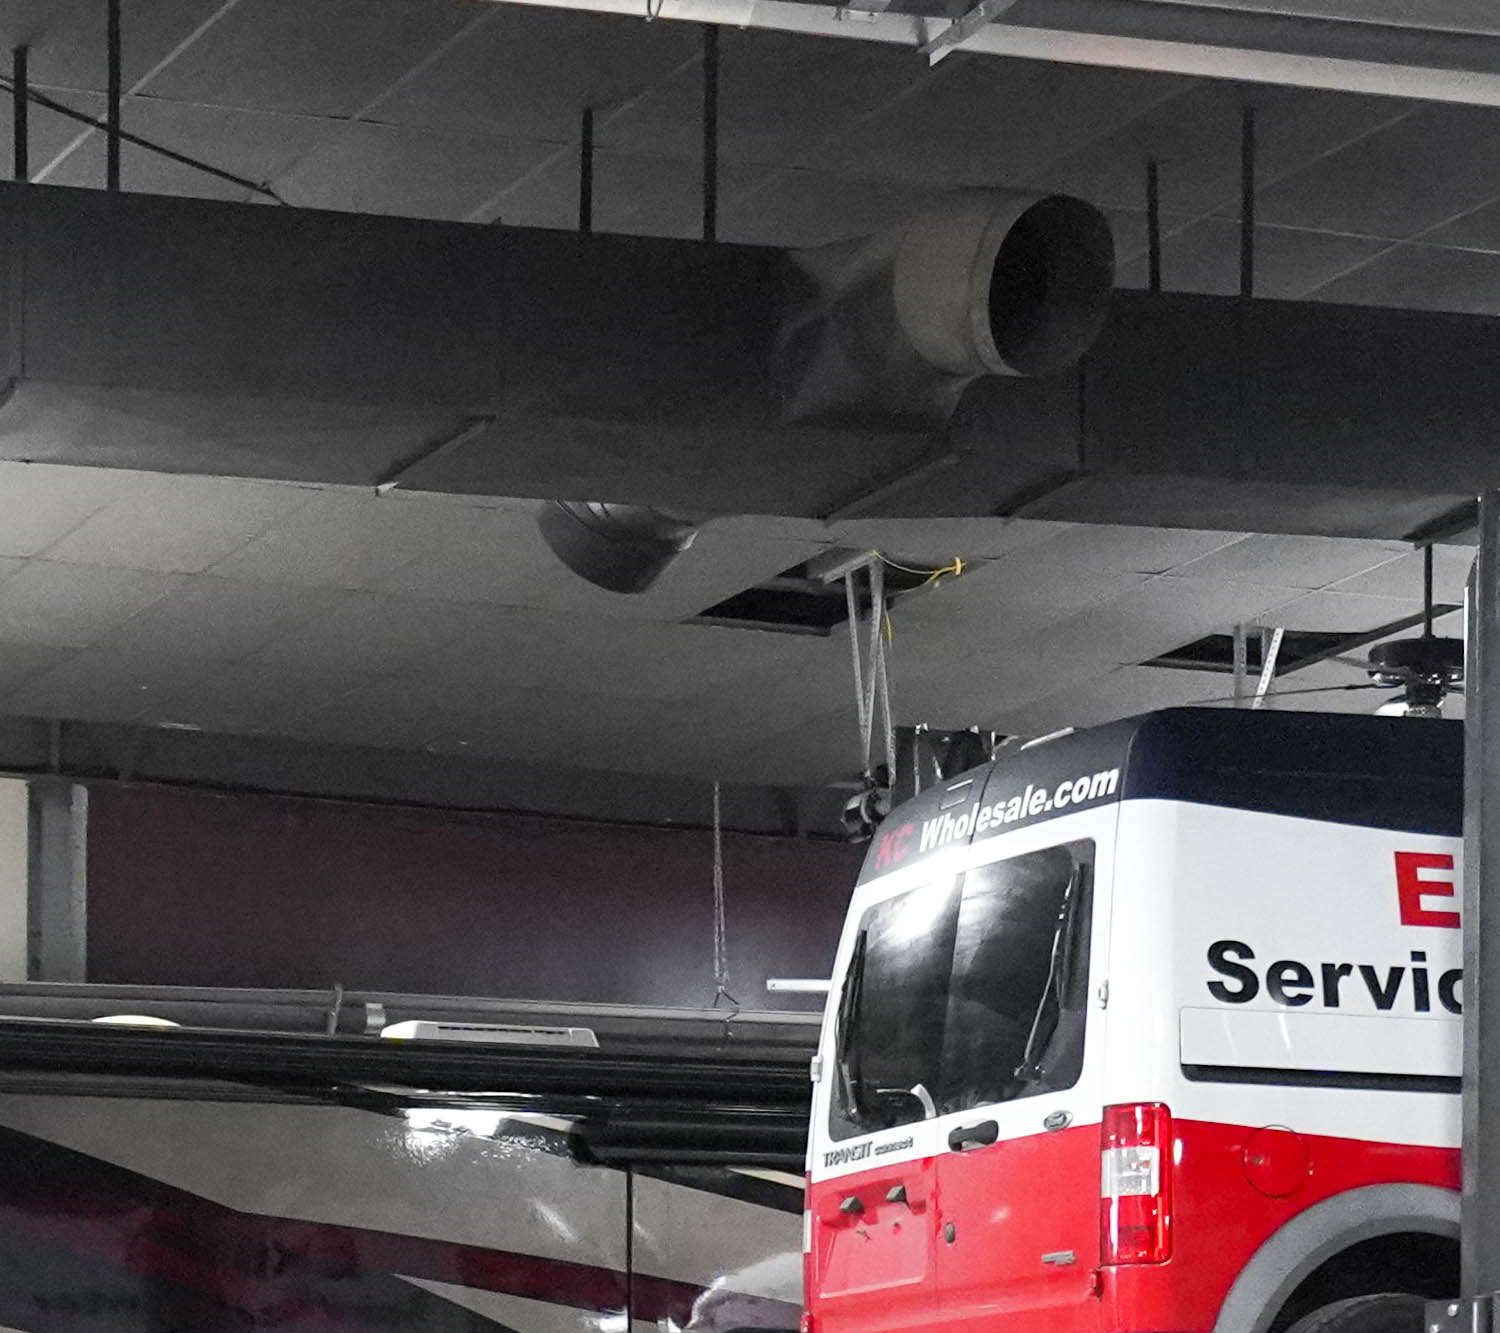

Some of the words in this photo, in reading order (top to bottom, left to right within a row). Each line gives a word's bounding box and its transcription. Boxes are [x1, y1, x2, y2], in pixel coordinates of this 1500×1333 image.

[874, 824, 913, 870] KC
[919, 768, 1119, 853] Wholesale.com
[1206, 939, 1464, 1013] Servic
[823, 1141, 873, 1168] TRANSIT
